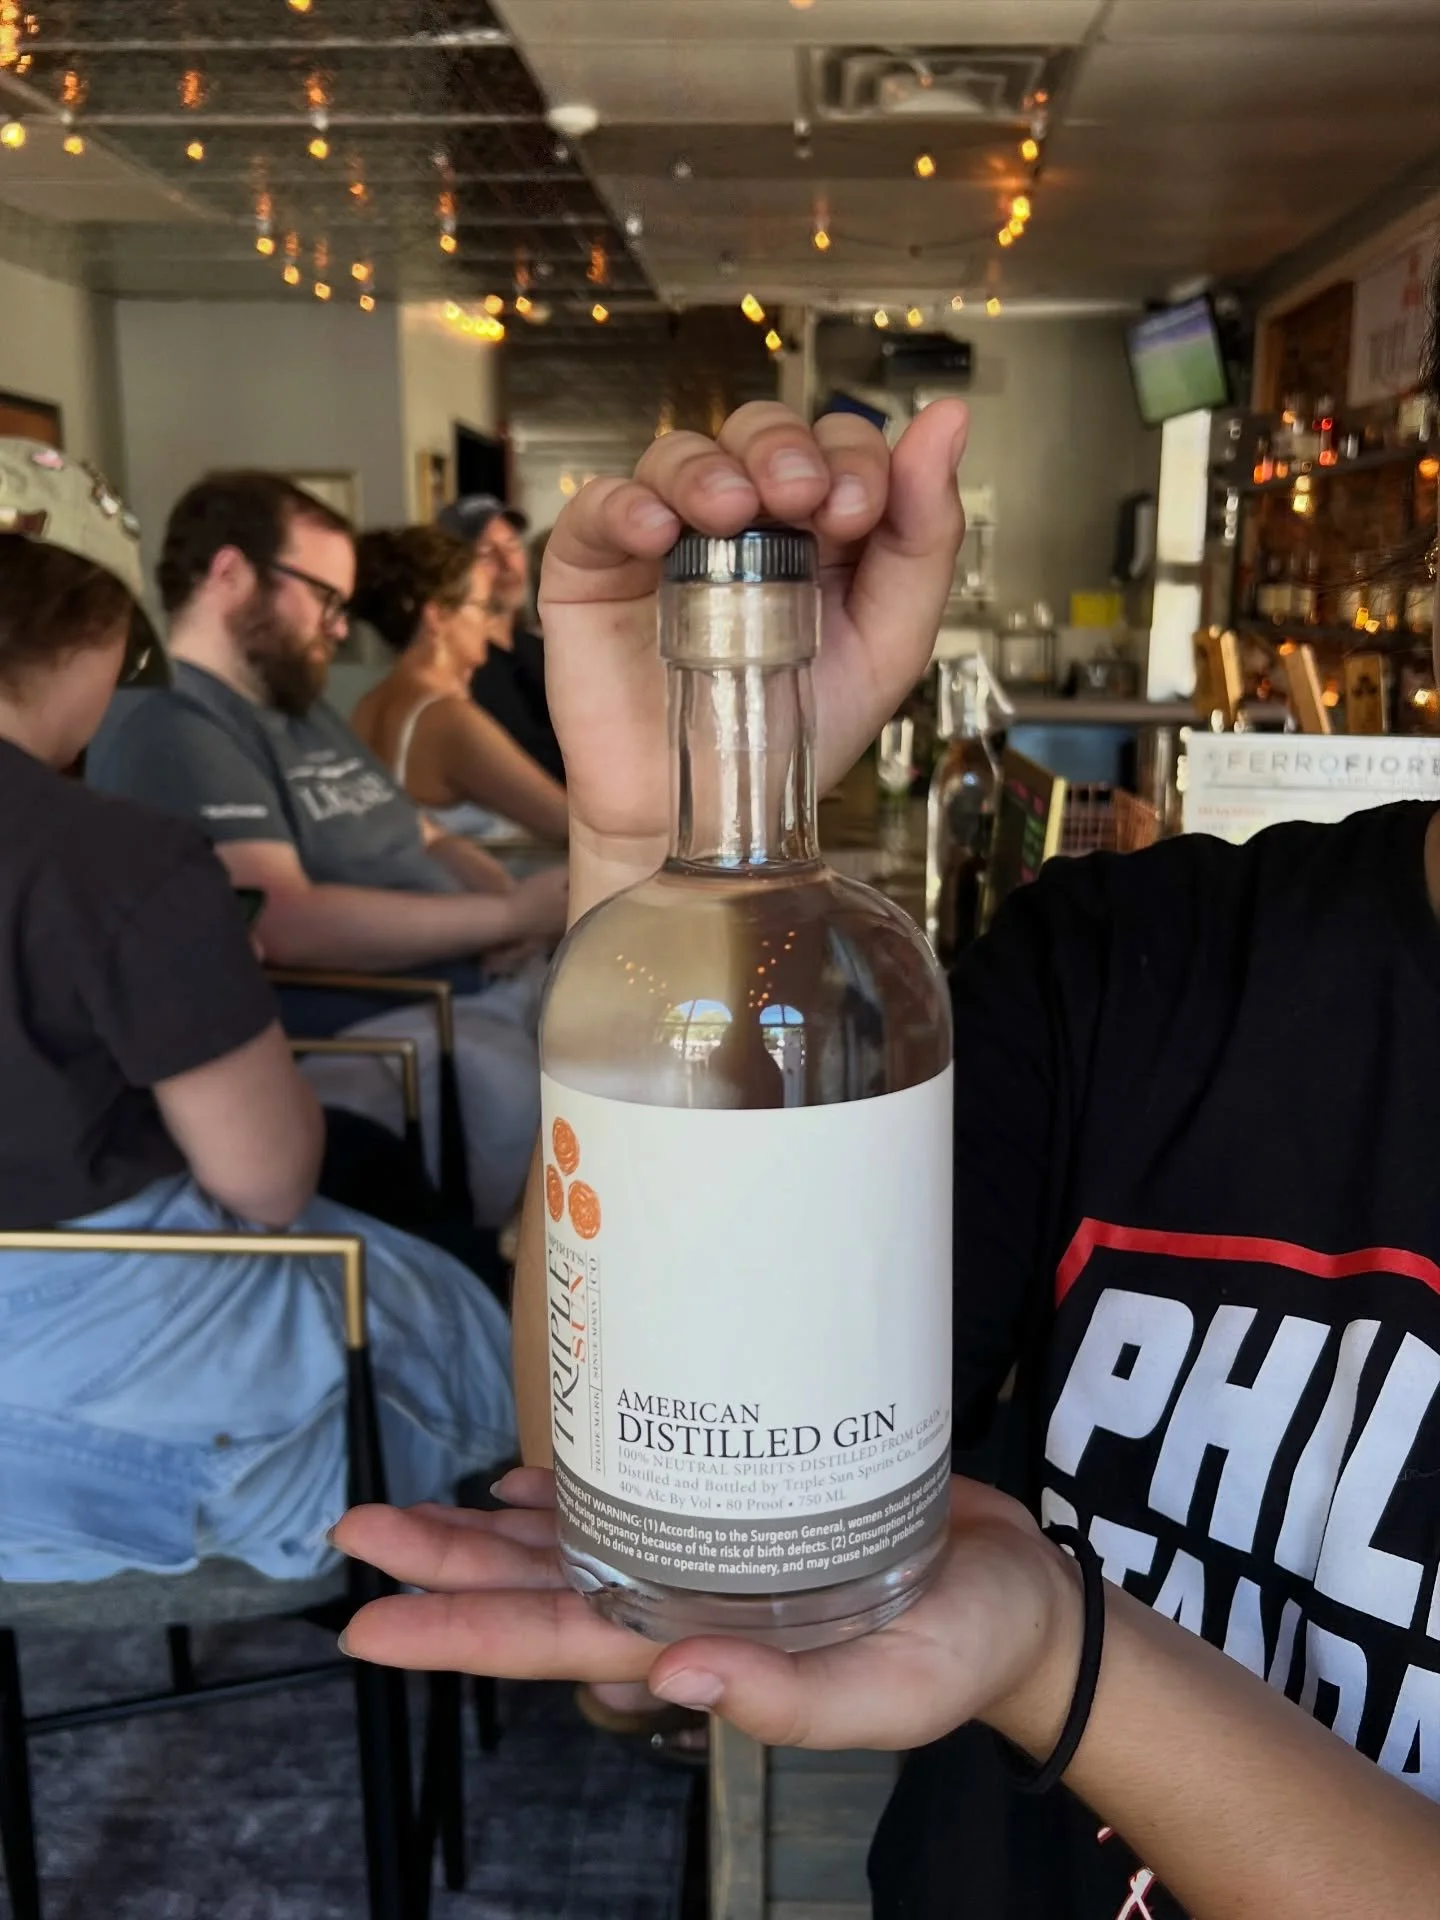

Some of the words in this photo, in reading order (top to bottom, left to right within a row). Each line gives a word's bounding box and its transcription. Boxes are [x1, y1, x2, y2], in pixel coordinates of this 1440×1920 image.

[570, 1267, 587, 1364] SUN
[549, 1247, 579, 1445] TRIPLE
[617, 1388, 761, 1424] AMERICAN
[617, 1412, 821, 1459] DISTILLED
[833, 1402, 897, 1448] GIN
[618, 1445, 649, 1464] 100%
[653, 1453, 729, 1476] NEUTRAL
[733, 1461, 795, 1476] SPIRITS
[800, 1443, 878, 1473] DISTILLED
[881, 1426, 914, 1453] FROM
[618, 1461, 670, 1486] Distilled
[674, 1478, 699, 1490] and
[705, 1478, 756, 1493] Bottled
[762, 1479, 778, 1496] by
[783, 1473, 824, 1493] Triple
[829, 1470, 854, 1484] Sun
[857, 1456, 894, 1480] Spirits
[1045, 1287, 1440, 1642] PHIL
[592, 1496, 642, 1527] WARNING:
[643, 1516, 659, 1534] (1)
[659, 1521, 713, 1544] According
[715, 1529, 727, 1542] to
[729, 1528, 748, 1542] the
[750, 1529, 799, 1544] Surgeon
[801, 1518, 846, 1538] General,
[848, 1509, 883, 1529] women
[884, 1493, 911, 1518] should
[911, 1486, 923, 1501] not
[619, 1480, 642, 1496] 40%
[646, 1489, 666, 1502] Alc
[670, 1493, 686, 1506] By
[690, 1495, 712, 1509] Vol
[726, 1499, 742, 1511] 80
[747, 1499, 783, 1511] Proof
[799, 1492, 822, 1507] 750
[825, 1487, 847, 1504] ML
[574, 1501, 596, 1526] during
[596, 1516, 640, 1545] pregnancy
[641, 1532, 683, 1553] because
[685, 1541, 697, 1554] of
[699, 1543, 717, 1557] the
[720, 1545, 741, 1558] risk
[742, 1545, 755, 1558] of
[757, 1544, 785, 1558] birth
[787, 1540, 830, 1556] defects.
[831, 1535, 847, 1552] (2)
[848, 1514, 906, 1545] Consumption
[907, 1506, 915, 1521] of
[581, 1521, 602, 1545] ability
[602, 1534, 611, 1547] to
[612, 1540, 635, 1557] drive
[636, 1550, 642, 1559] a
[644, 1551, 659, 1563] car
[660, 1556, 672, 1566] or
[673, 1558, 716, 1573] operate
[718, 1561, 780, 1577] machinery,
[782, 1558, 804, 1572] and
[806, 1556, 830, 1570] may
[832, 1548, 861, 1565] cause
[862, 1535, 891, 1557] health
